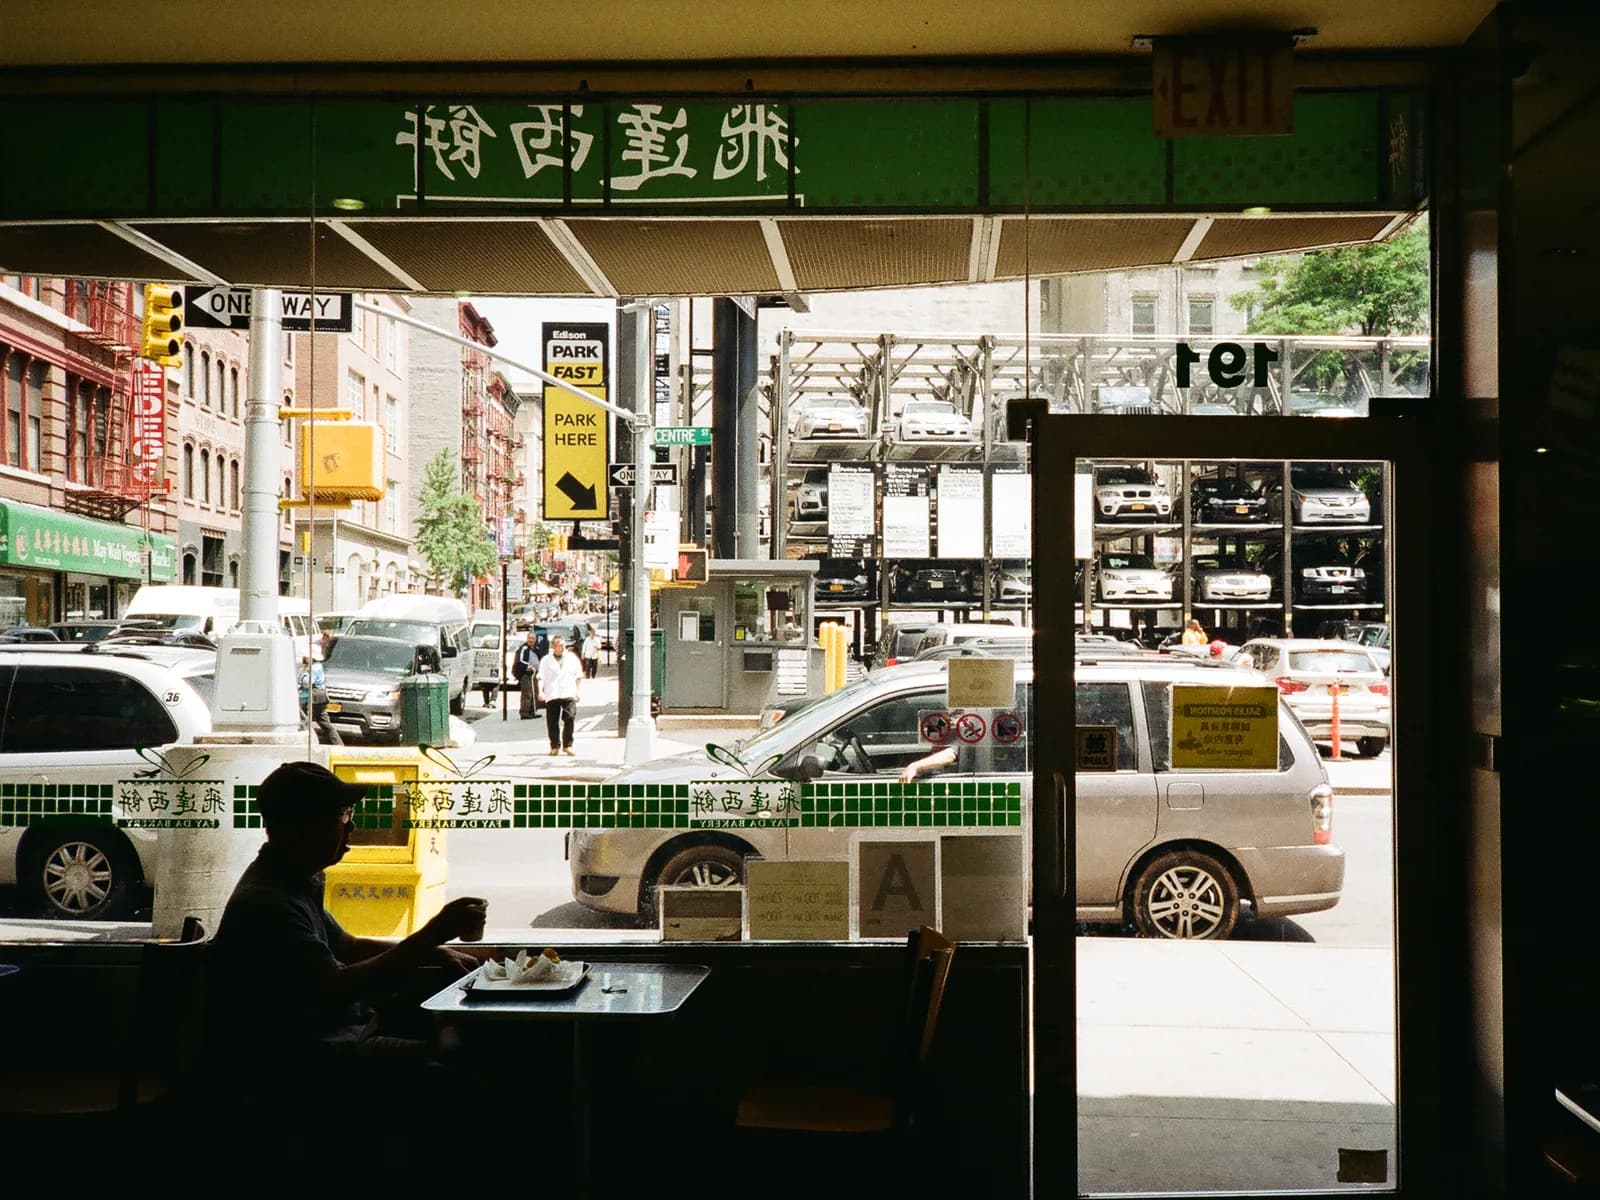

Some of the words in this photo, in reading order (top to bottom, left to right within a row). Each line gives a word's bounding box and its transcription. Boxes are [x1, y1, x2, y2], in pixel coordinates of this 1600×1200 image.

[1172, 49, 1279, 127] EXIT
[282, 296, 331, 317] WAY
[552, 330, 587, 339] Edison
[552, 345, 599, 358] PARK
[553, 366, 597, 379] FAST
[554, 413, 597, 427] PARK
[554, 432, 598, 446] HERE
[655, 428, 696, 443] CENTRE
[165, 692, 181, 703] 36
